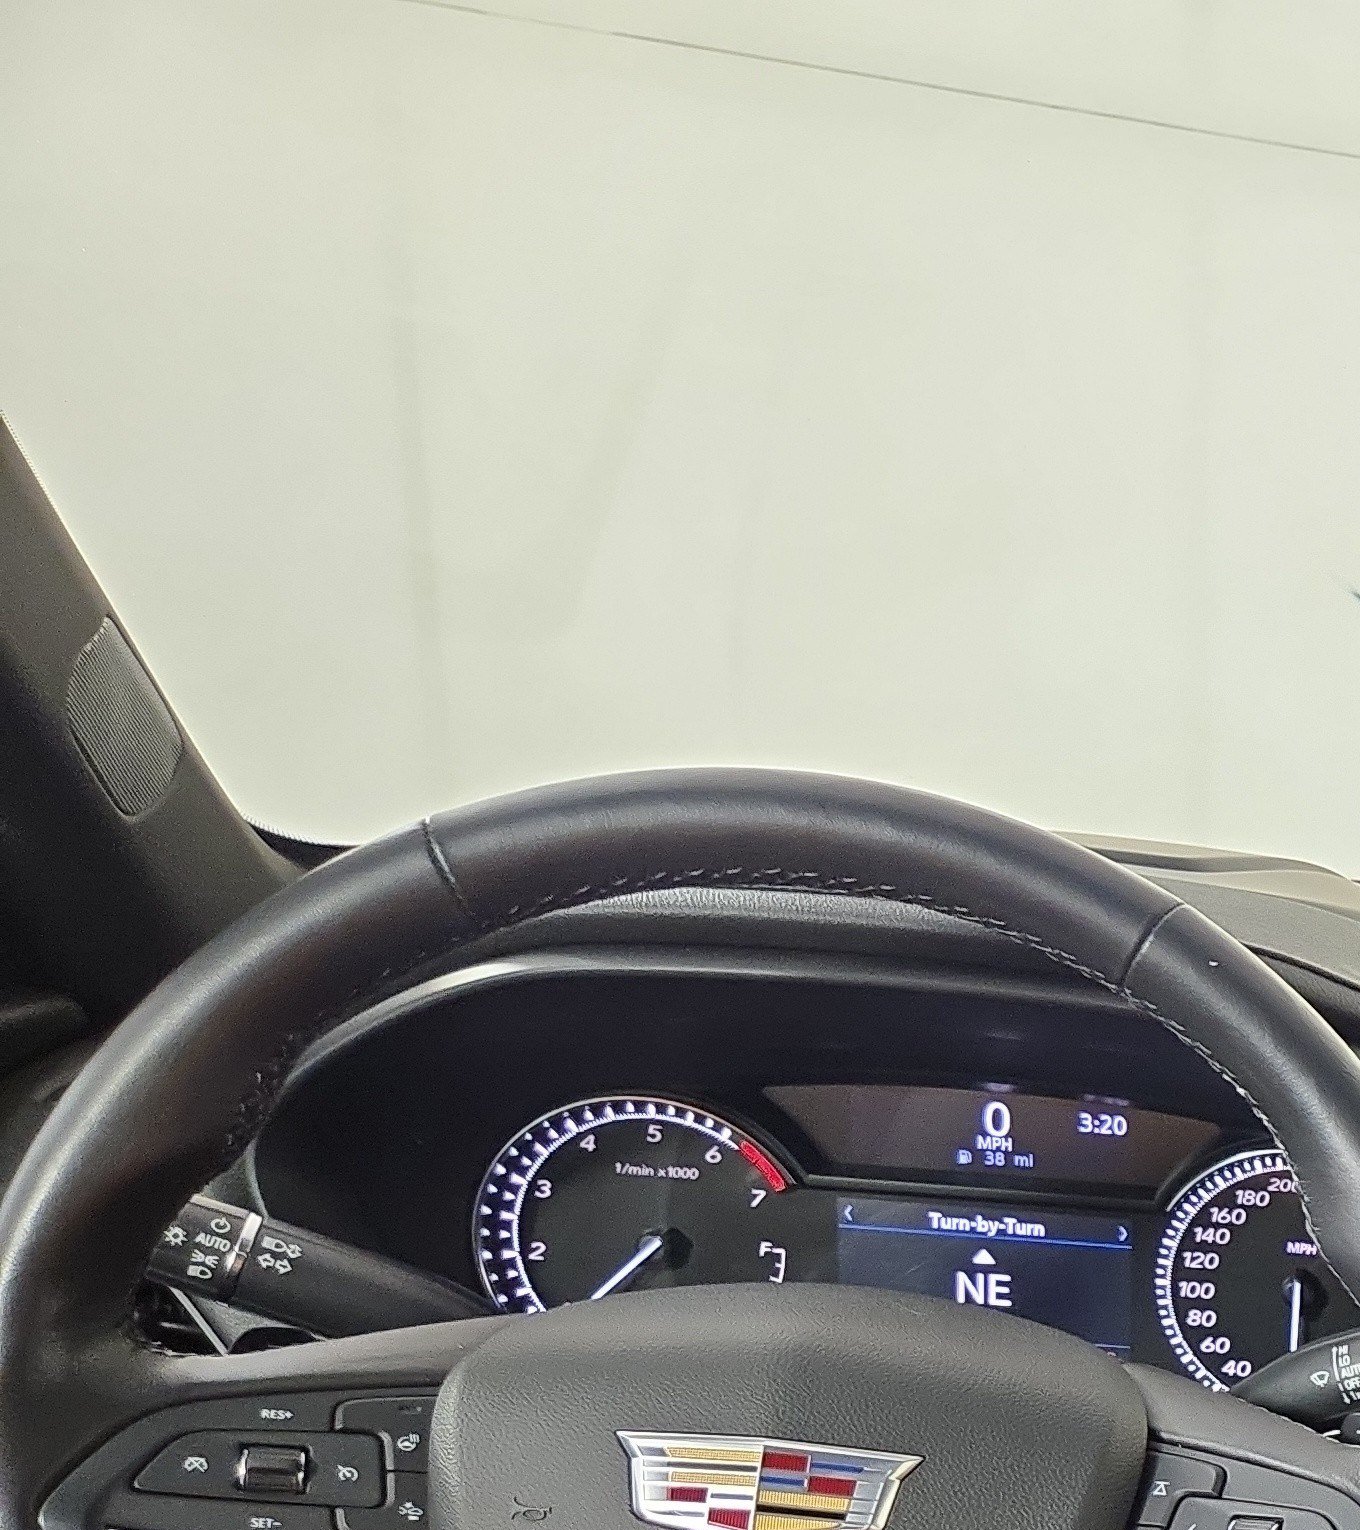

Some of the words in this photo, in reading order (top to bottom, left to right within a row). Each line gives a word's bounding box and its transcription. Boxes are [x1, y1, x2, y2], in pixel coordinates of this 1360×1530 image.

[982, 1101, 1011, 1135] 0
[1078, 1112, 1128, 1137] 3:20
[647, 1125, 663, 1143] 5
[580, 1134, 597, 1153] 4
[976, 1136, 1013, 1152] MPH
[705, 1145, 723, 1164] 6
[984, 1152, 1005, 1167] 38
[1014, 1151, 1034, 1168] mi
[615, 1162, 654, 1177] 1/min
[657, 1165, 700, 1181] x1000
[534, 1179, 552, 1199] 3
[750, 1188, 766, 1207] 7
[1235, 1190, 1270, 1207] 180
[928, 1211, 1046, 1239] Turn-by-Turn
[1210, 1207, 1246, 1225] 160
[195, 1231, 231, 1253] AUTO
[1194, 1227, 1231, 1244] 140
[528, 1241, 547, 1261] 2
[1286, 1241, 1317, 1255] MPH
[1183, 1252, 1219, 1269] 120
[954, 1271, 1012, 1307] NE
[1179, 1281, 1215, 1299] 100
[1186, 1309, 1217, 1327] 80
[1200, 1337, 1231, 1354] 60
[1221, 1360, 1251, 1377] 40
[1339, 1355, 1351, 1367] LO
[1343, 1377, 1360, 1390] OFF
